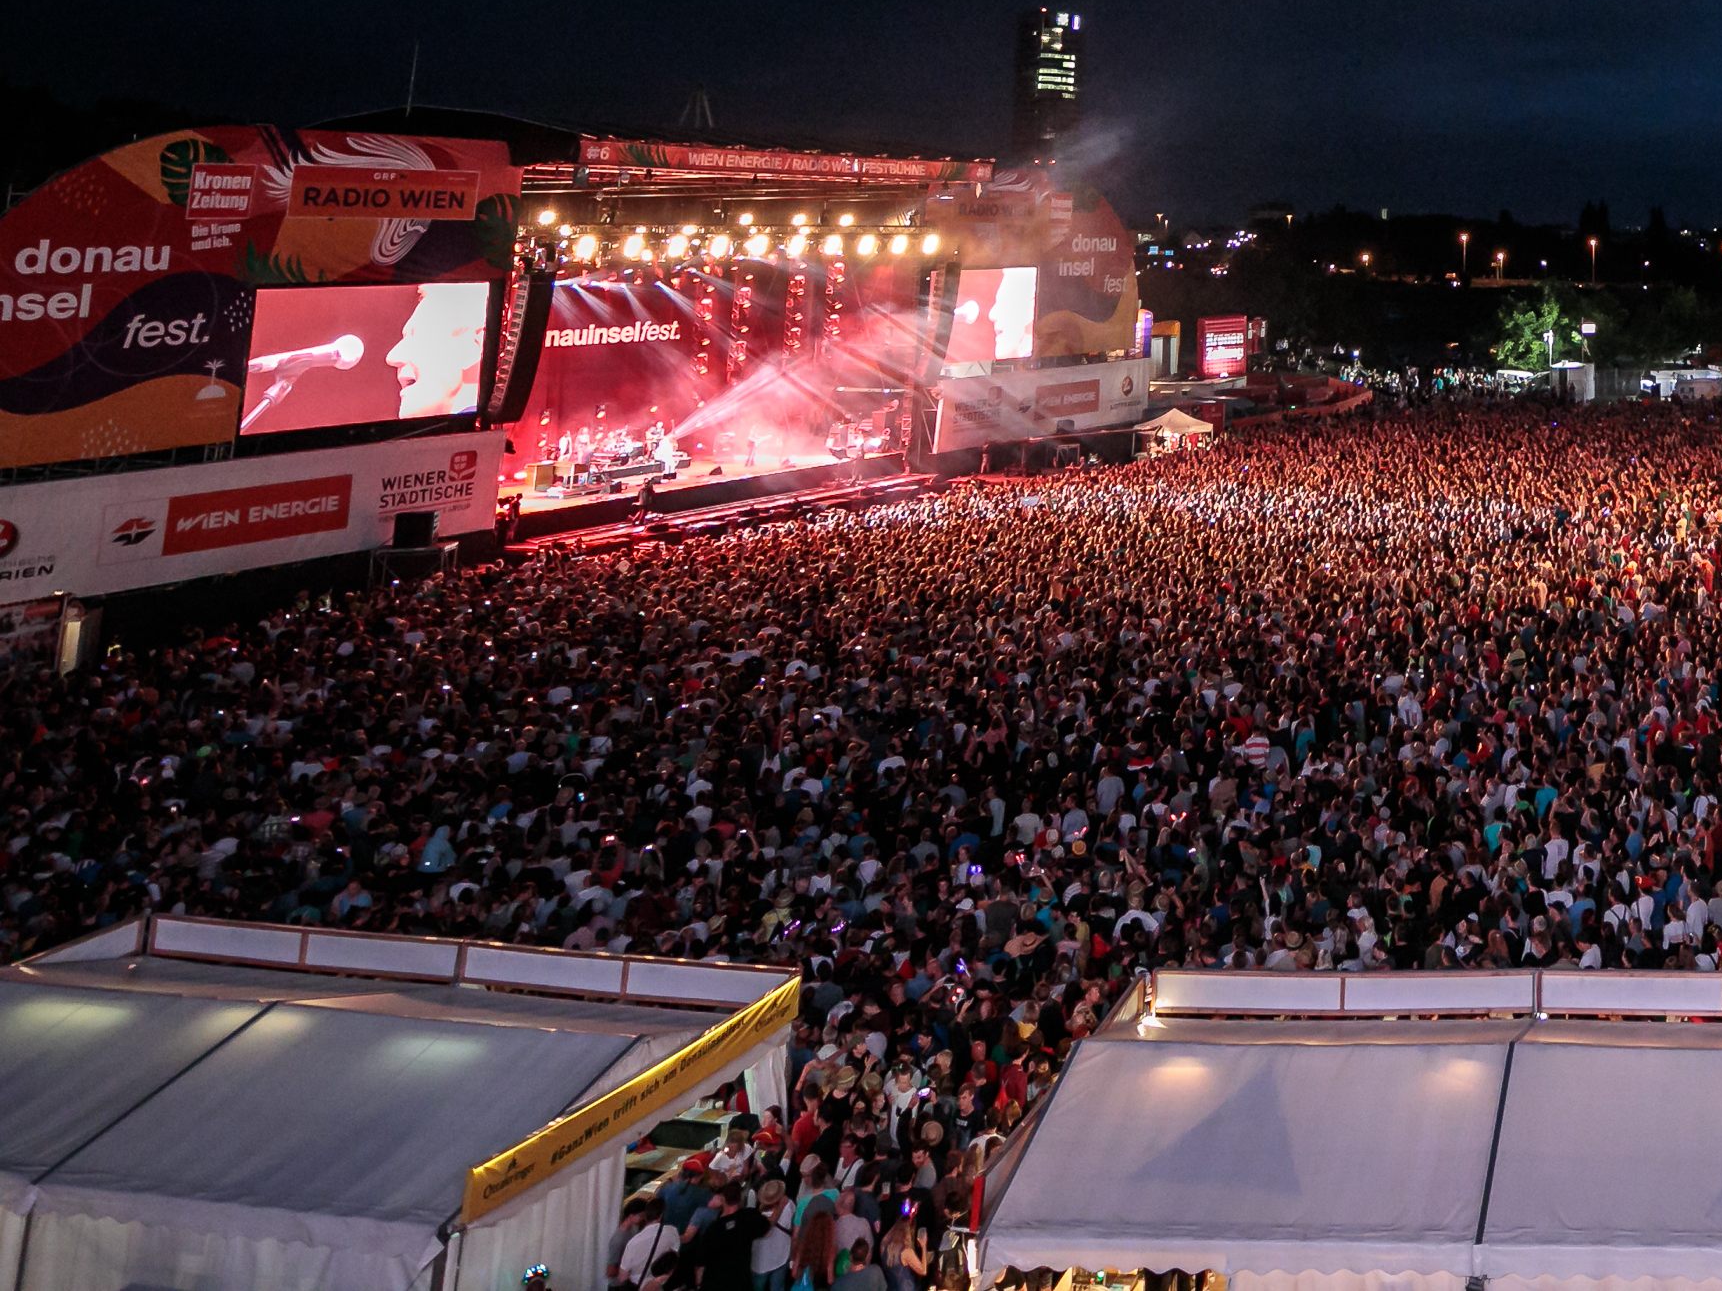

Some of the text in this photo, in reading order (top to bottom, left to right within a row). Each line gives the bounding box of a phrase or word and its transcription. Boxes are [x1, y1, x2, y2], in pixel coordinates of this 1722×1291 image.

[688, 152, 724, 167] WIEN
[725, 154, 783, 169] ENERGIE
[792, 159, 829, 171] RADIO
[831, 159, 858, 172] WIE
[862, 162, 926, 175] FESTBÜHNE
[194, 171, 252, 190] Kronen
[191, 191, 249, 210] Zeitung
[303, 186, 466, 209] RADIO WIEN
[1072, 233, 1117, 252] donau
[15, 239, 171, 275] donau
[1059, 257, 1095, 276] insel
[122, 312, 210, 349] fest.
[382, 470, 447, 492] WIENER
[379, 482, 475, 508] STÄDTISCHE
[176, 495, 340, 532] WIEN ENERGIE
[613, 1096, 638, 1120] trifft
[640, 1077, 660, 1100] sich
[662, 1068, 677, 1084] am
